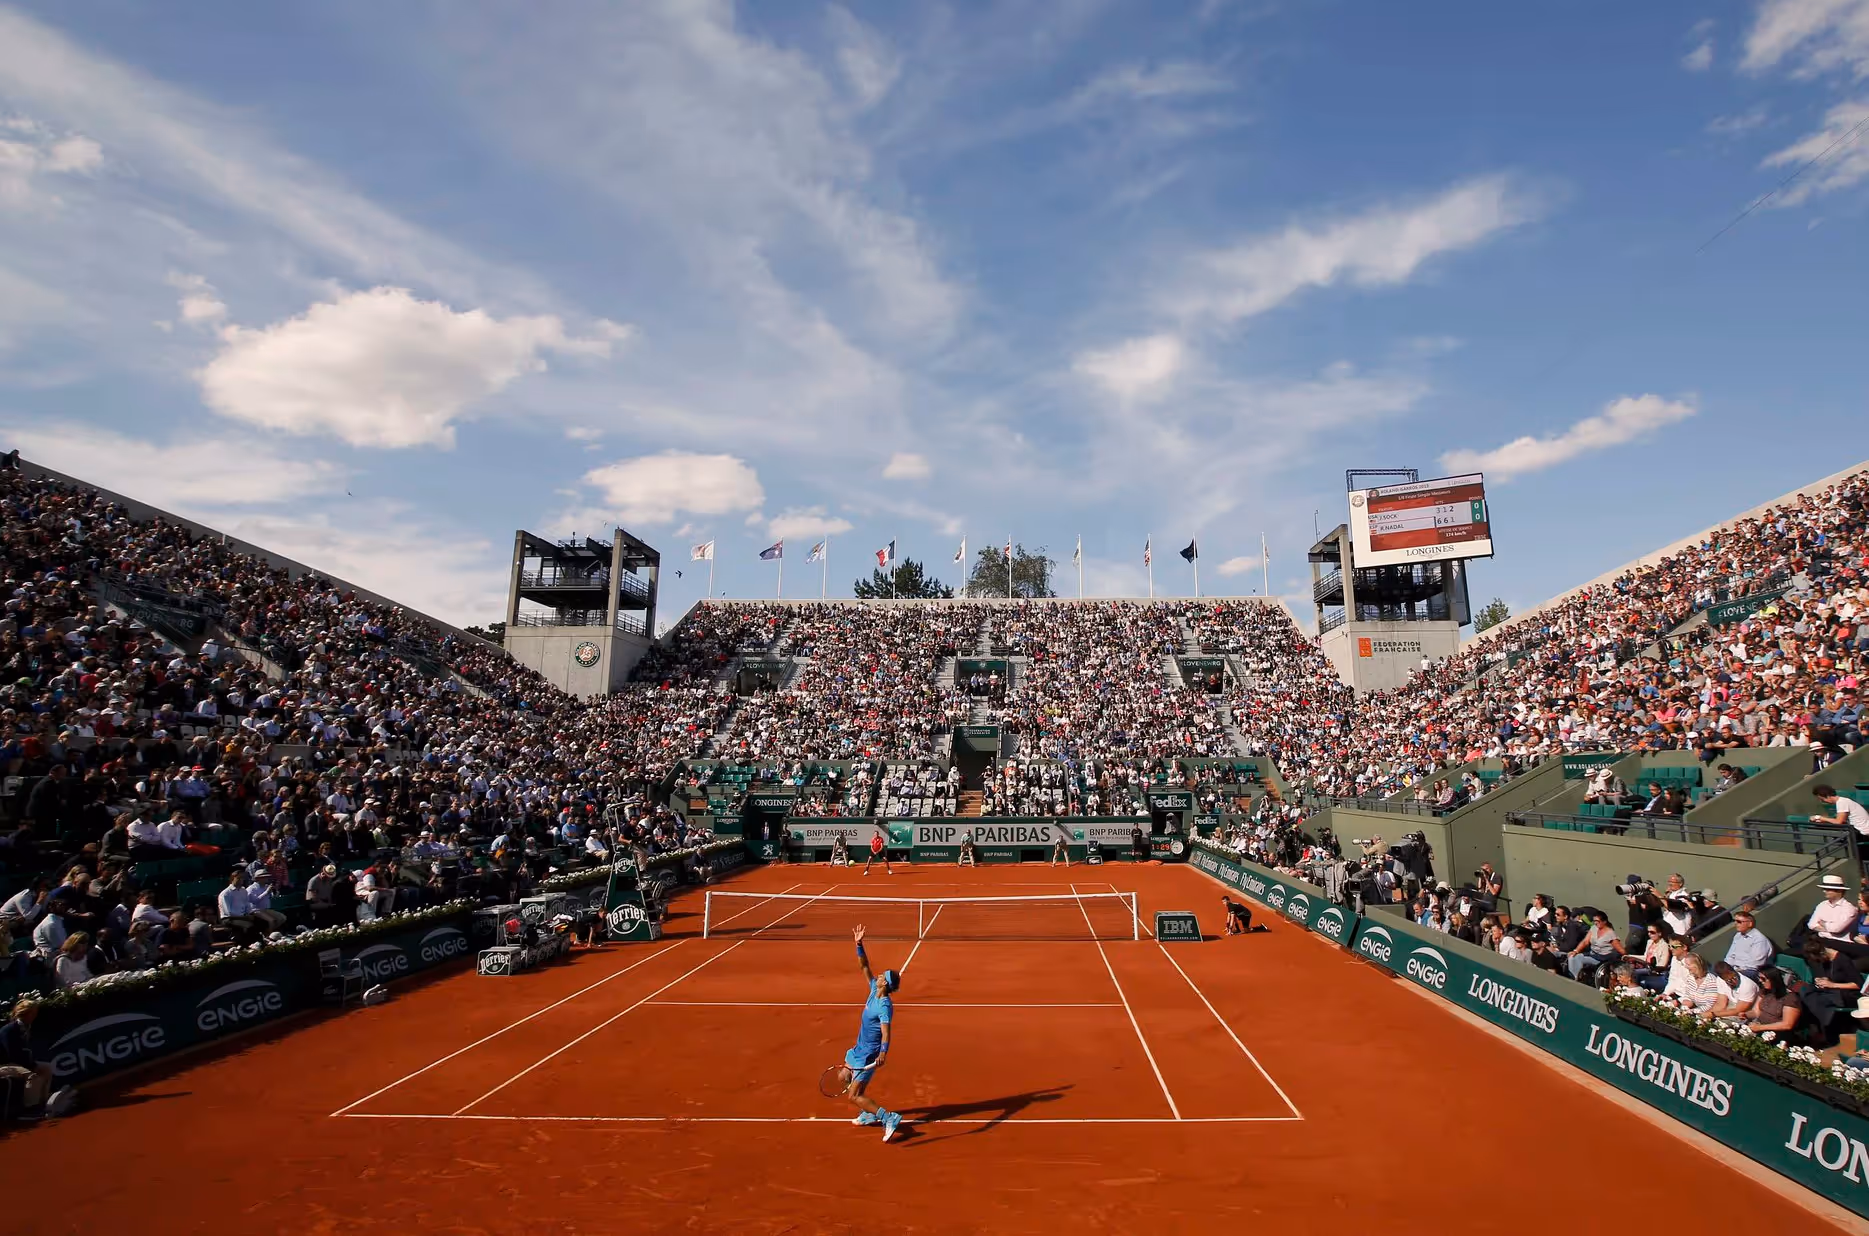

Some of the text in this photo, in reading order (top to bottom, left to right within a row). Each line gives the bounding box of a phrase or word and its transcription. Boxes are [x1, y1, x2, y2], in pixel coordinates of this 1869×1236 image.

[1406, 545, 1454, 556] LONGINES
[1150, 796, 1187, 808] FedEx
[920, 827, 1050, 842] BNP PARIBAS
[1164, 920, 1192, 933] IBM
[1468, 973, 1559, 1034] LONGINES
[1585, 1024, 1733, 1117] LONGINES
